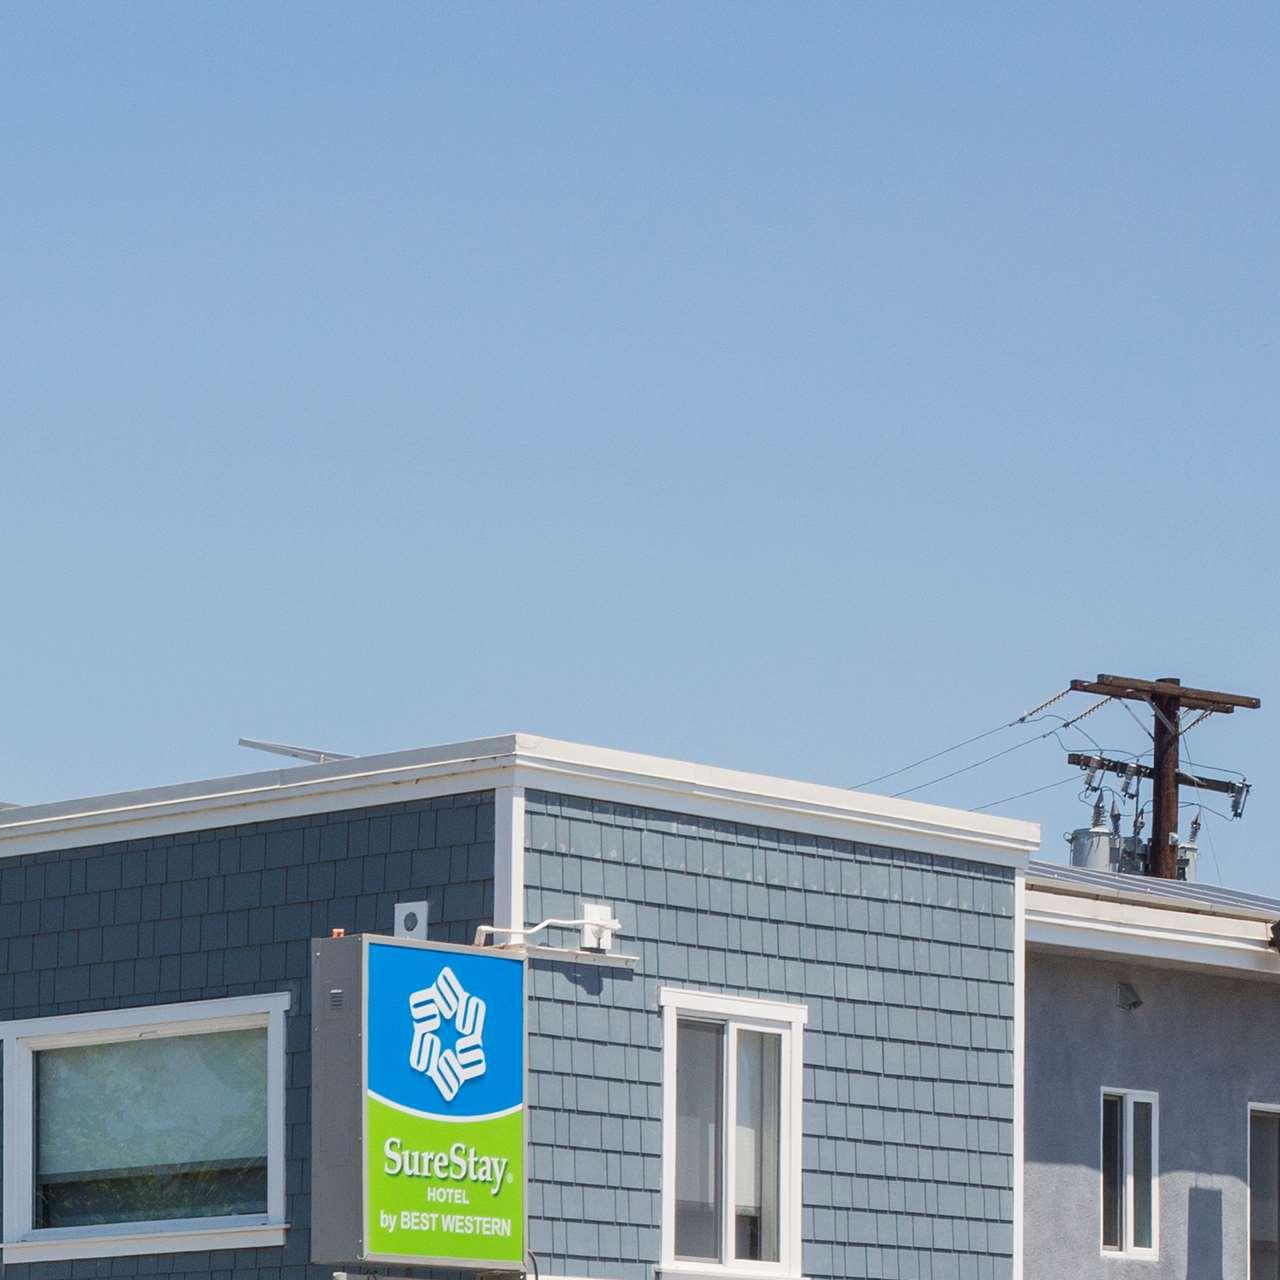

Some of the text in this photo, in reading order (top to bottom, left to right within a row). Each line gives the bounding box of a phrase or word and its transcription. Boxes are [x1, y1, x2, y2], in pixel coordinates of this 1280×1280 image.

[427, 1186, 470, 1204] HOTEL
[380, 1209, 512, 1236] by BEST WESTERN
